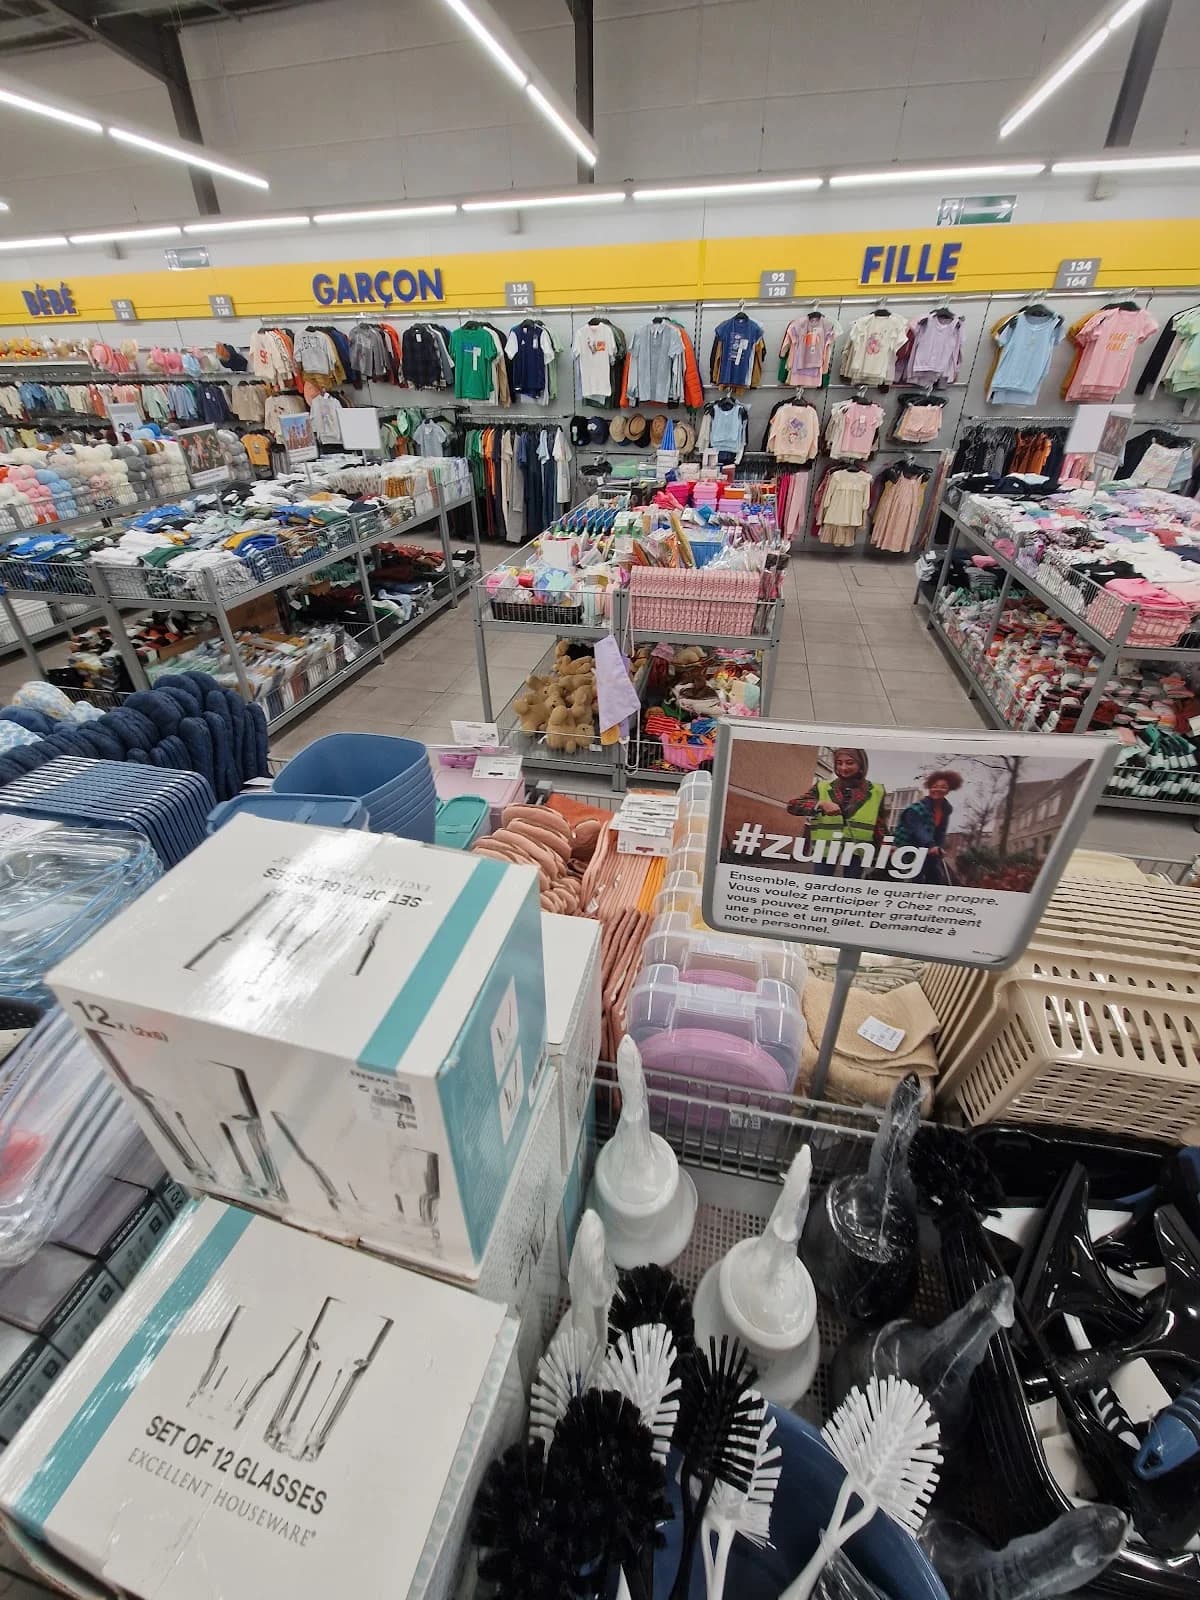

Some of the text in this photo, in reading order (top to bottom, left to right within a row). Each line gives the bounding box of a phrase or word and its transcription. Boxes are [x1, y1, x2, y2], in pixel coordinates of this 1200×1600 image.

[771, 272, 785, 282] 92
[861, 242, 963, 284] FILLE
[1070, 261, 1092, 271] 134
[312, 268, 444, 308] GARÇON
[511, 284, 528, 293] 134
[768, 287, 786, 297] 128
[1065, 276, 1087, 287] 164
[21, 281, 78, 316] BÉBÉ
[513, 297, 529, 306] 164
[732, 822, 929, 879] #zuinig
[388, 893, 423, 909] SET
[728, 882, 977, 917] Vous voulez participer ? Chez nous,
[730, 870, 999, 907] Ensemble, gardons le quartier propre.
[724, 914, 830, 935] notre personnel.
[726, 905, 957, 937] une pince et un gilet. Demandez à
[727, 893, 982, 928] vous pouvez emprunter gratuitement
[128, 1447, 213, 1499] EXCELLENT
[146, 1415, 328, 1515] SET OF 12 GLASSES
